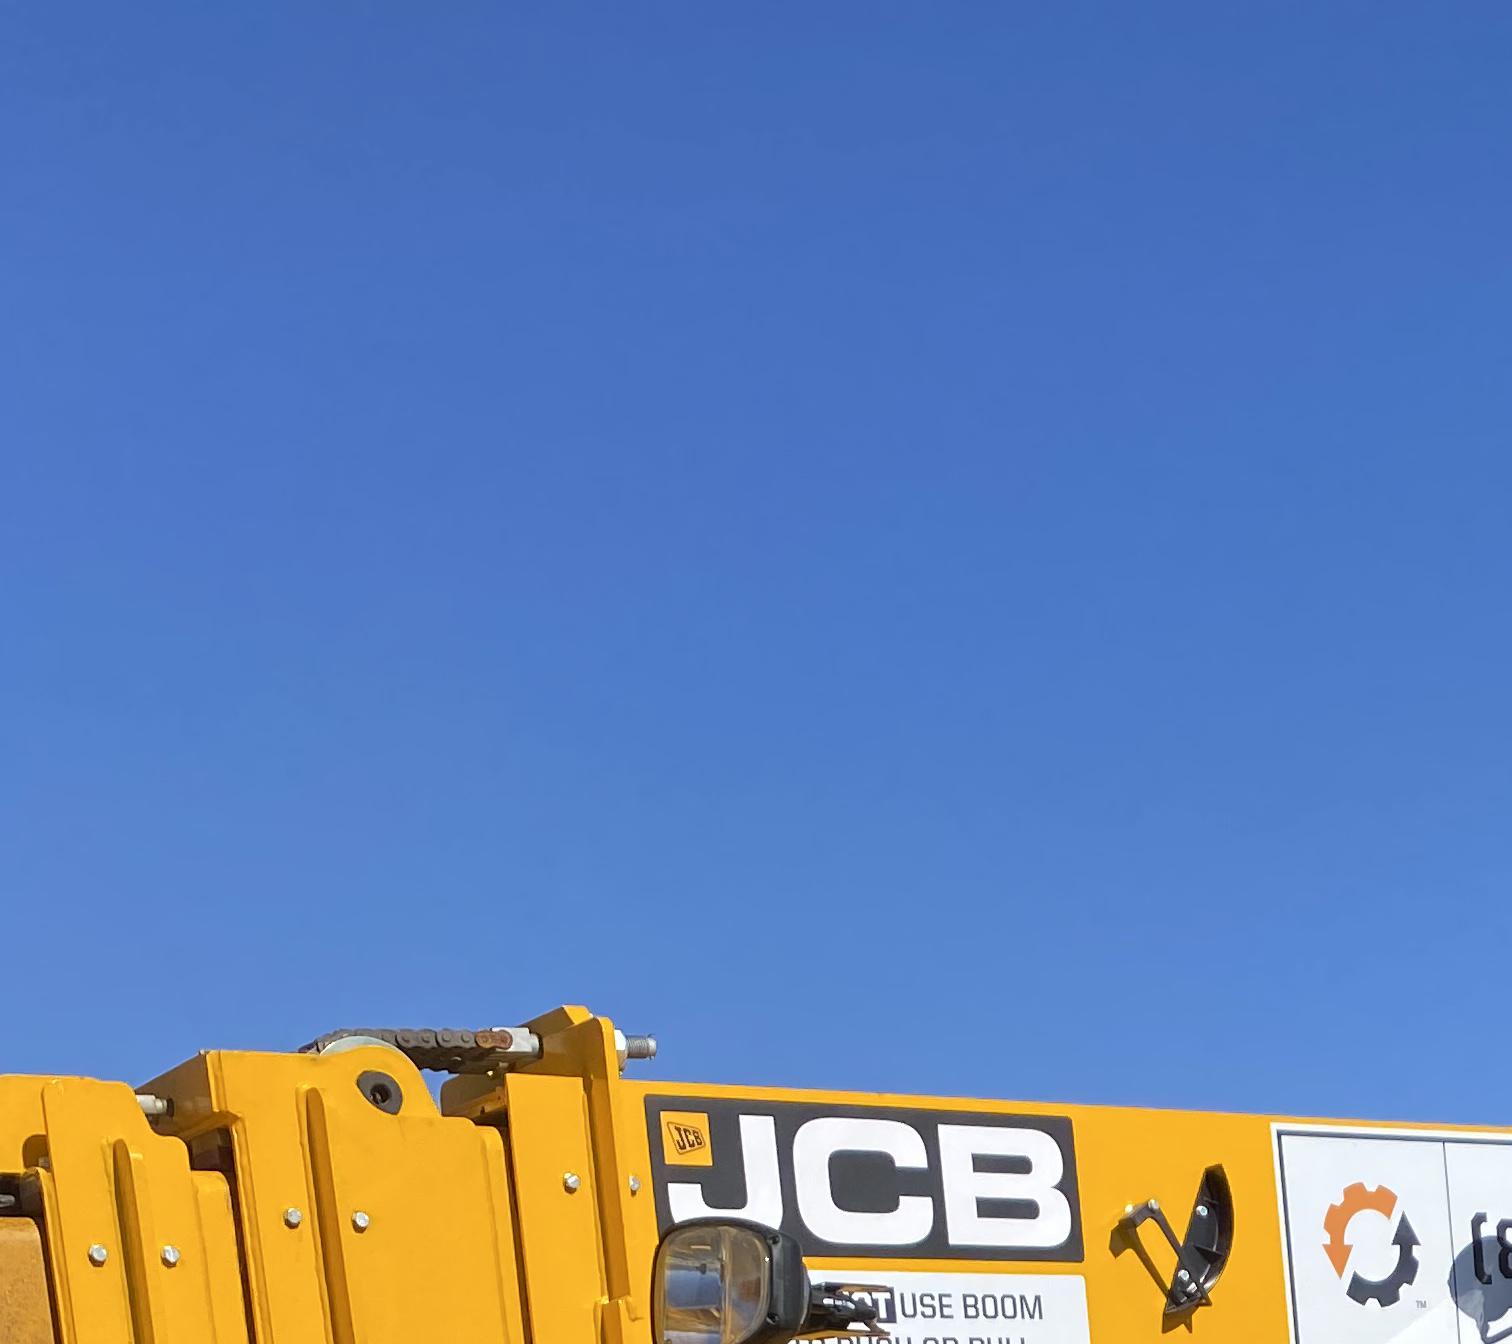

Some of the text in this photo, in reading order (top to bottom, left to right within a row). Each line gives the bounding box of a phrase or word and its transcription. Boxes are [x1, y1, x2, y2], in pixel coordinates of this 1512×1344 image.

[675, 1126, 702, 1150] JCB
[668, 1114, 1072, 1247] JCB
[900, 1293, 954, 1320] USE
[963, 1293, 1044, 1320] BOOM
